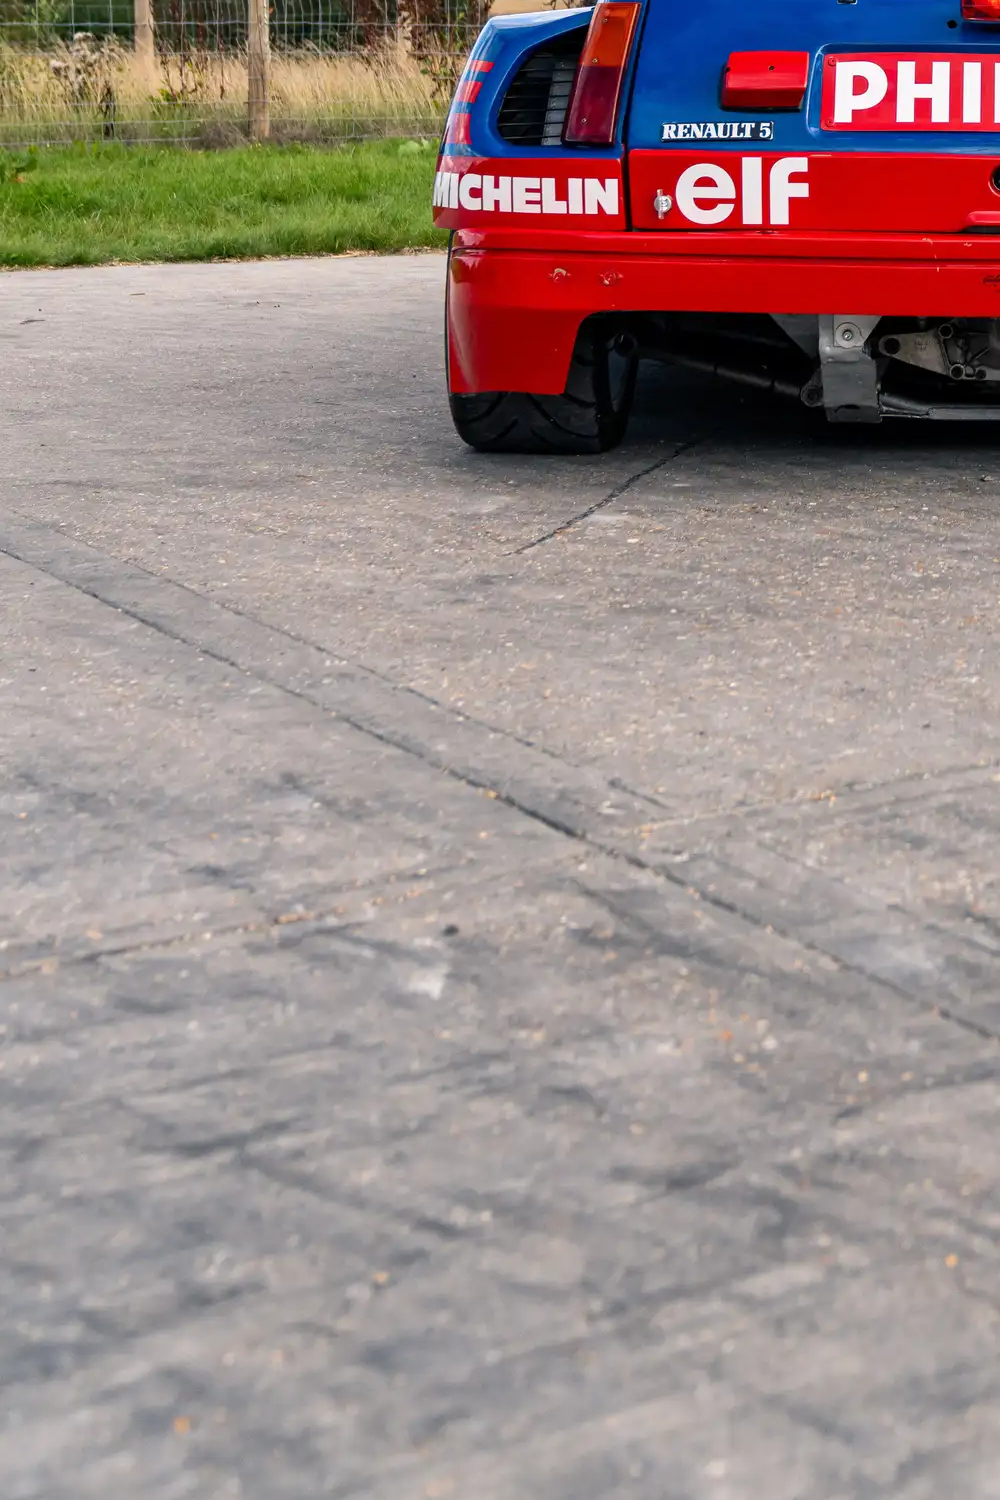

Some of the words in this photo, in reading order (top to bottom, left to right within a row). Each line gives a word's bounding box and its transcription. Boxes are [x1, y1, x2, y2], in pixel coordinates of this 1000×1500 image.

[662, 122, 756, 140] RENAULT
[759, 122, 771, 139] 5
[432, 171, 619, 215] MICHELIN
[675, 156, 809, 225] elf
